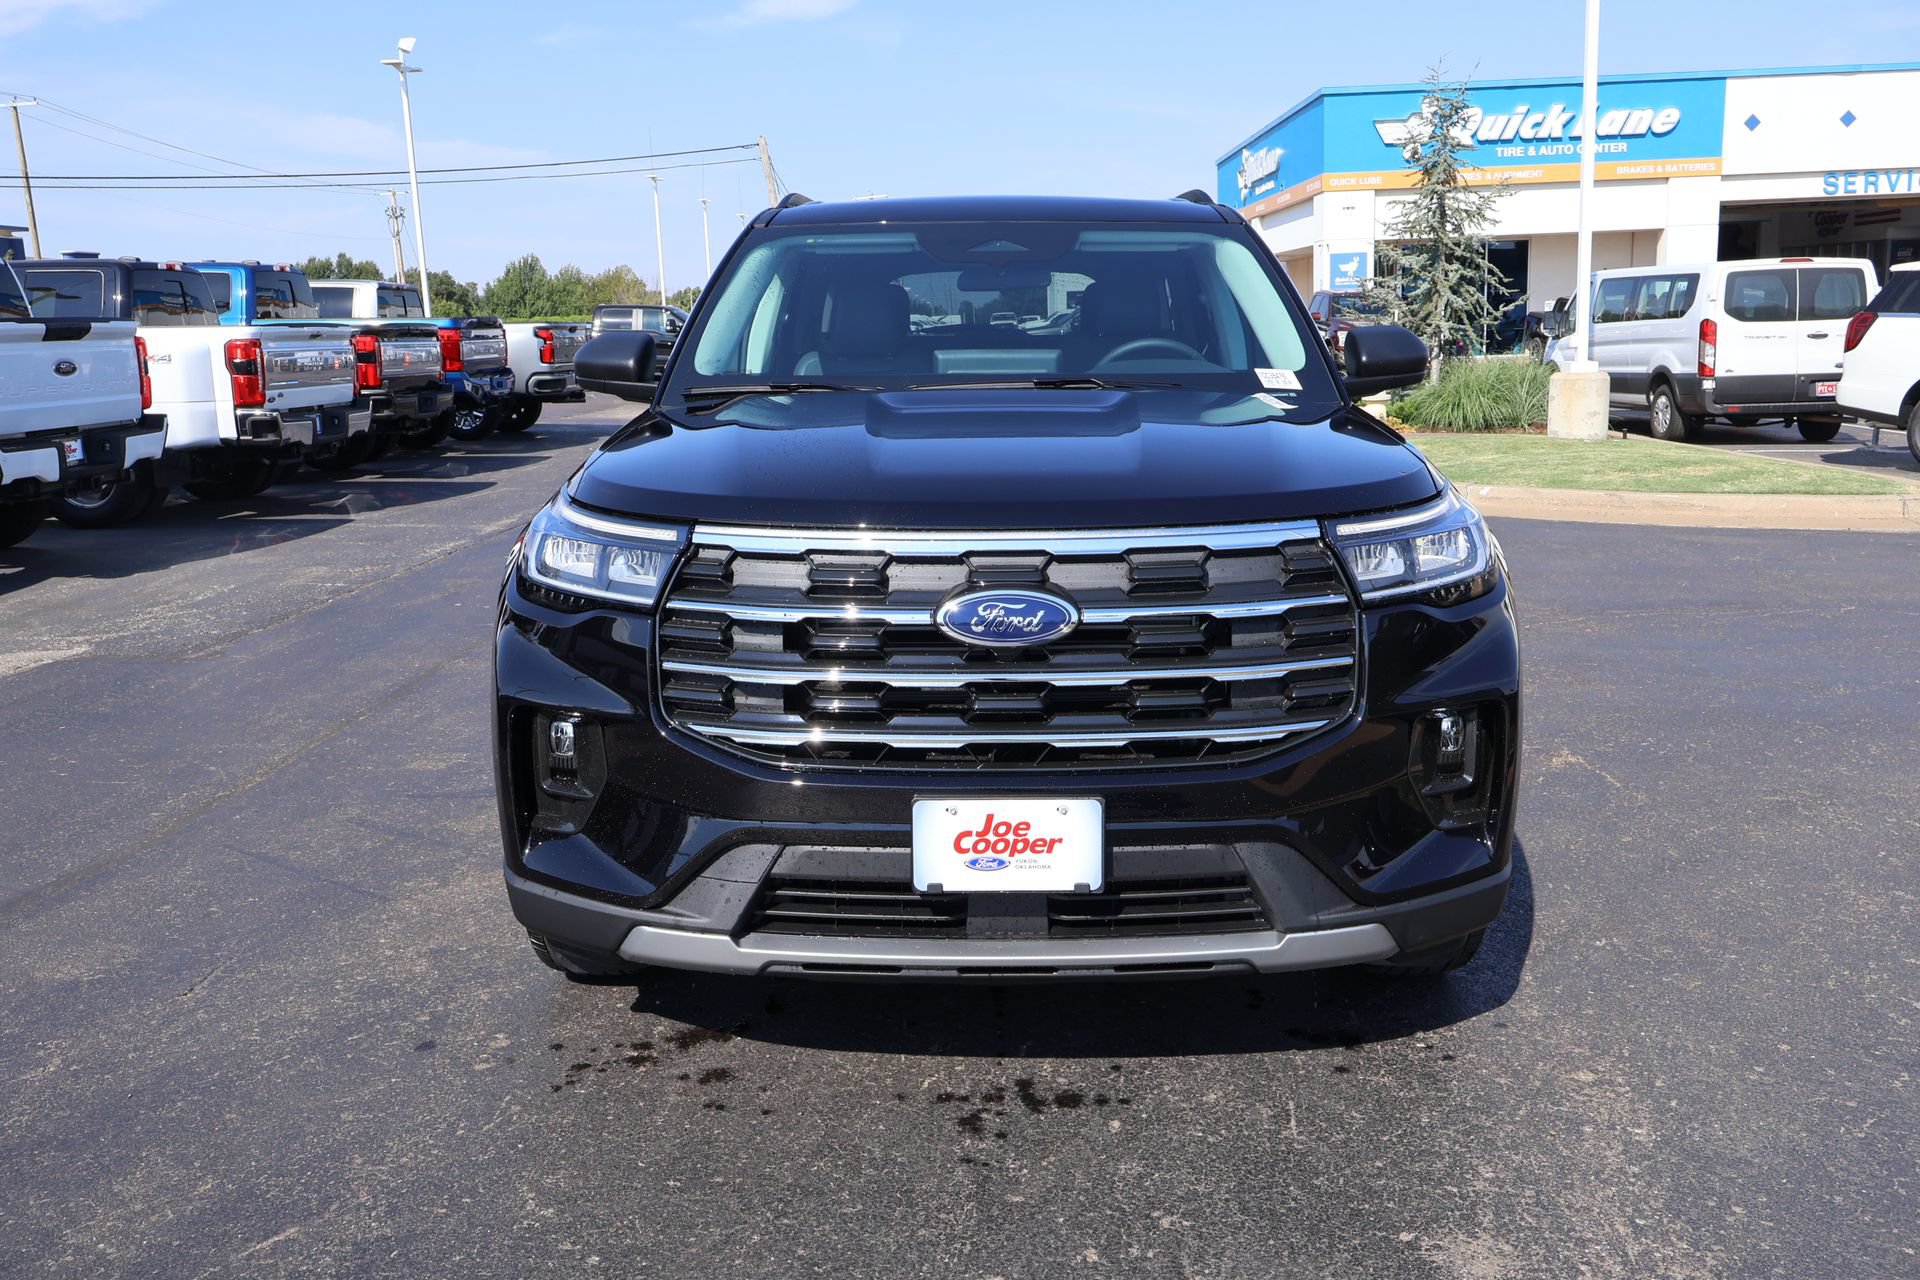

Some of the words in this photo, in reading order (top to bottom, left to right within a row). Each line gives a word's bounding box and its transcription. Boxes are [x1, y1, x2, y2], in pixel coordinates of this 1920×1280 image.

[1449, 104, 1577, 145] Quick
[1496, 146, 1525, 158] TIRE
[1528, 146, 1537, 157] &
[1539, 144, 1574, 156] AUTO
[1577, 142, 1628, 154] CNTER
[1456, 172, 1482, 181] IRES
[1494, 169, 1544, 180] ALIGNMENT
[1616, 165, 1654, 175] BRAKES
[1656, 164, 1664, 173] &
[1665, 163, 1716, 173] BATTERIES
[1329, 178, 1358, 187] QUICK
[1359, 176, 1382, 185] LUBE
[1823, 169, 1920, 195] SERVI
[970, 602, 1046, 633] Ford
[975, 813, 1031, 838] Joe
[953, 830, 1063, 858] Cooper
[975, 857, 1000, 868] Ford
